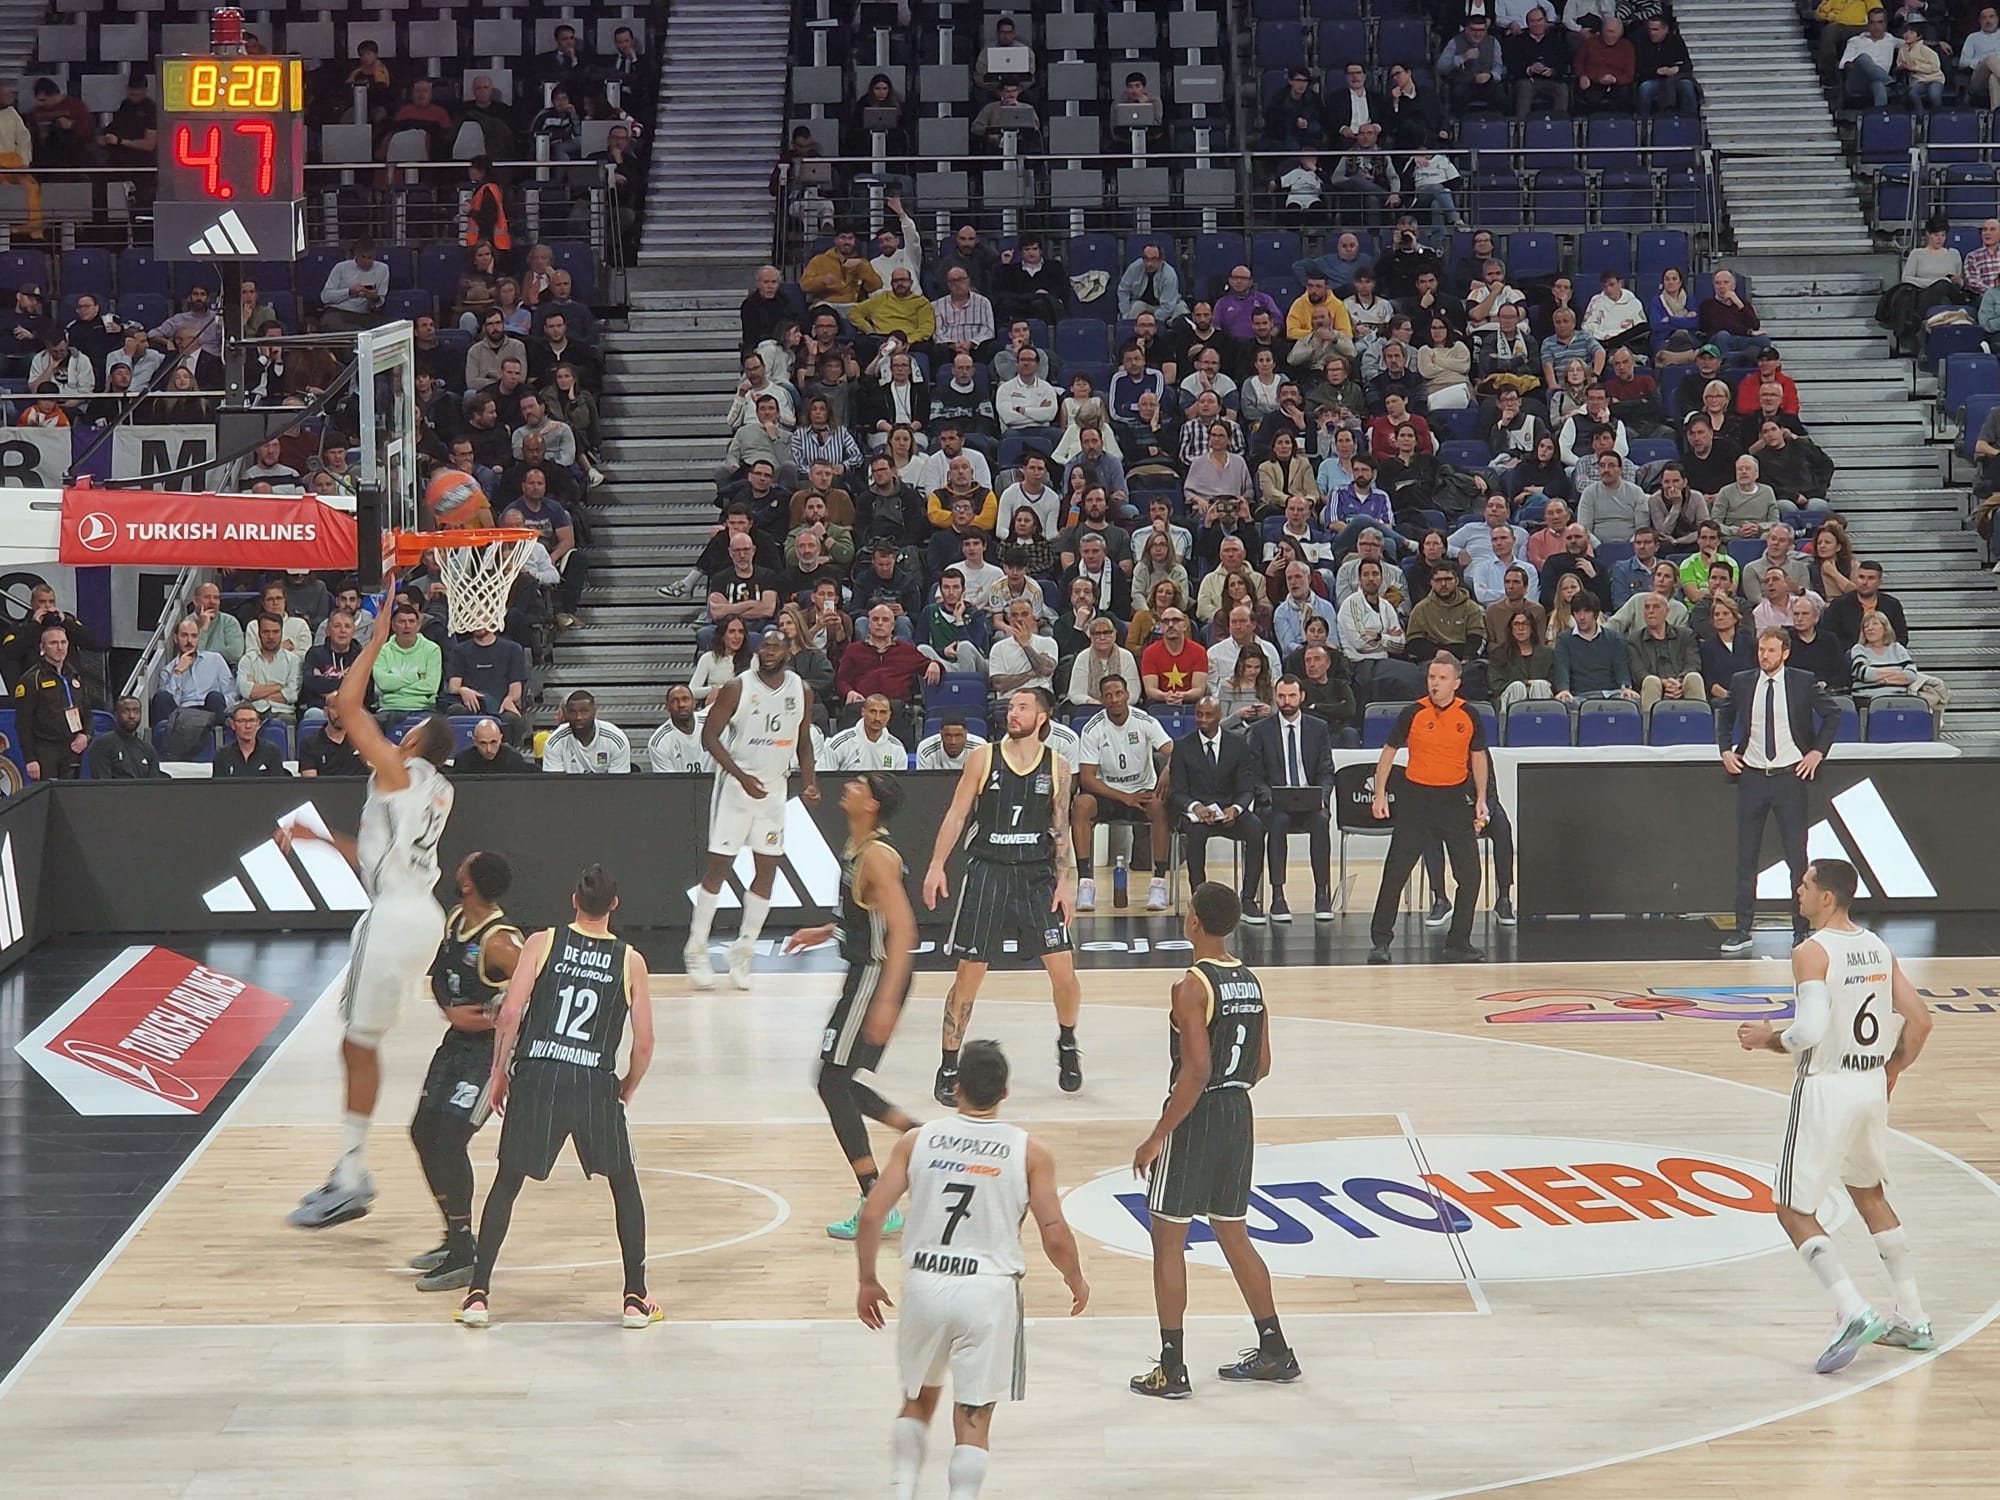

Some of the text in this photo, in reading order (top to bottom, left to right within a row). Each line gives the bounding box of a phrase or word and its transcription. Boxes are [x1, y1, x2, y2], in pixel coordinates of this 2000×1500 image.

[191, 65, 281, 106] 8:20
[178, 123, 273, 198] 4.7
[126, 523, 316, 541] TURKISH AIRLINES
[764, 713, 782, 733] 16
[1119, 753, 1127, 769] 8
[1011, 805, 1023, 826] 7
[989, 833, 1041, 845] SKWEEK
[563, 945, 612, 969] DE COLO
[118, 965, 248, 1066] TURKISH AIRLINES
[554, 985, 598, 1041] 12
[1853, 992, 1879, 1046] 6
[929, 1134, 1011, 1159] CAMPAZZO
[941, 1182, 976, 1246] 7
[912, 1251, 980, 1275] MADRID
